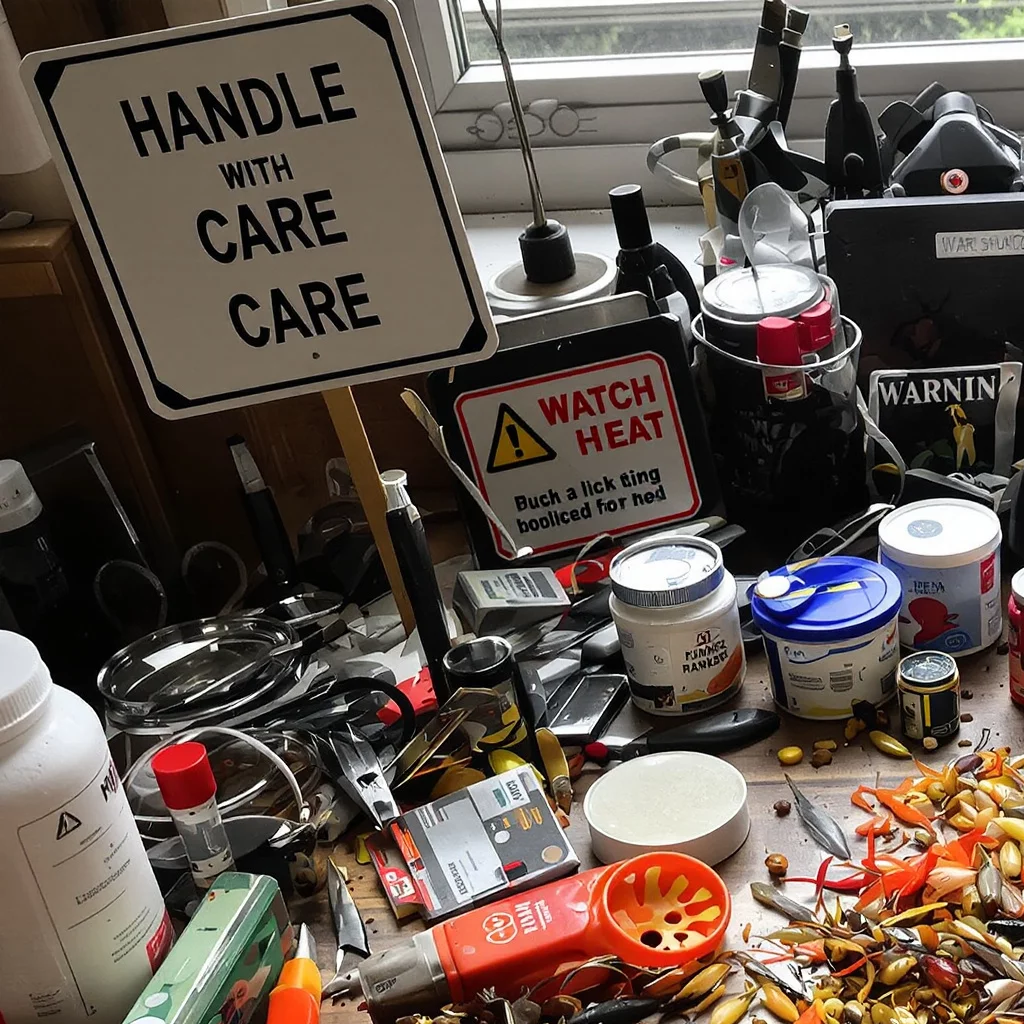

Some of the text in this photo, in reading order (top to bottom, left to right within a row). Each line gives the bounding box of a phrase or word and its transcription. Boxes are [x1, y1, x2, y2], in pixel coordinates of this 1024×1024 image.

[119, 62, 357, 157] HANDLE
[218, 153, 294, 190] WITH
[196, 189, 348, 264] CARE
[228, 272, 381, 347] CARE
[537, 374, 656, 426] WATCH
[575, 410, 664, 456] HEAT
[566, 487, 578, 500] a
